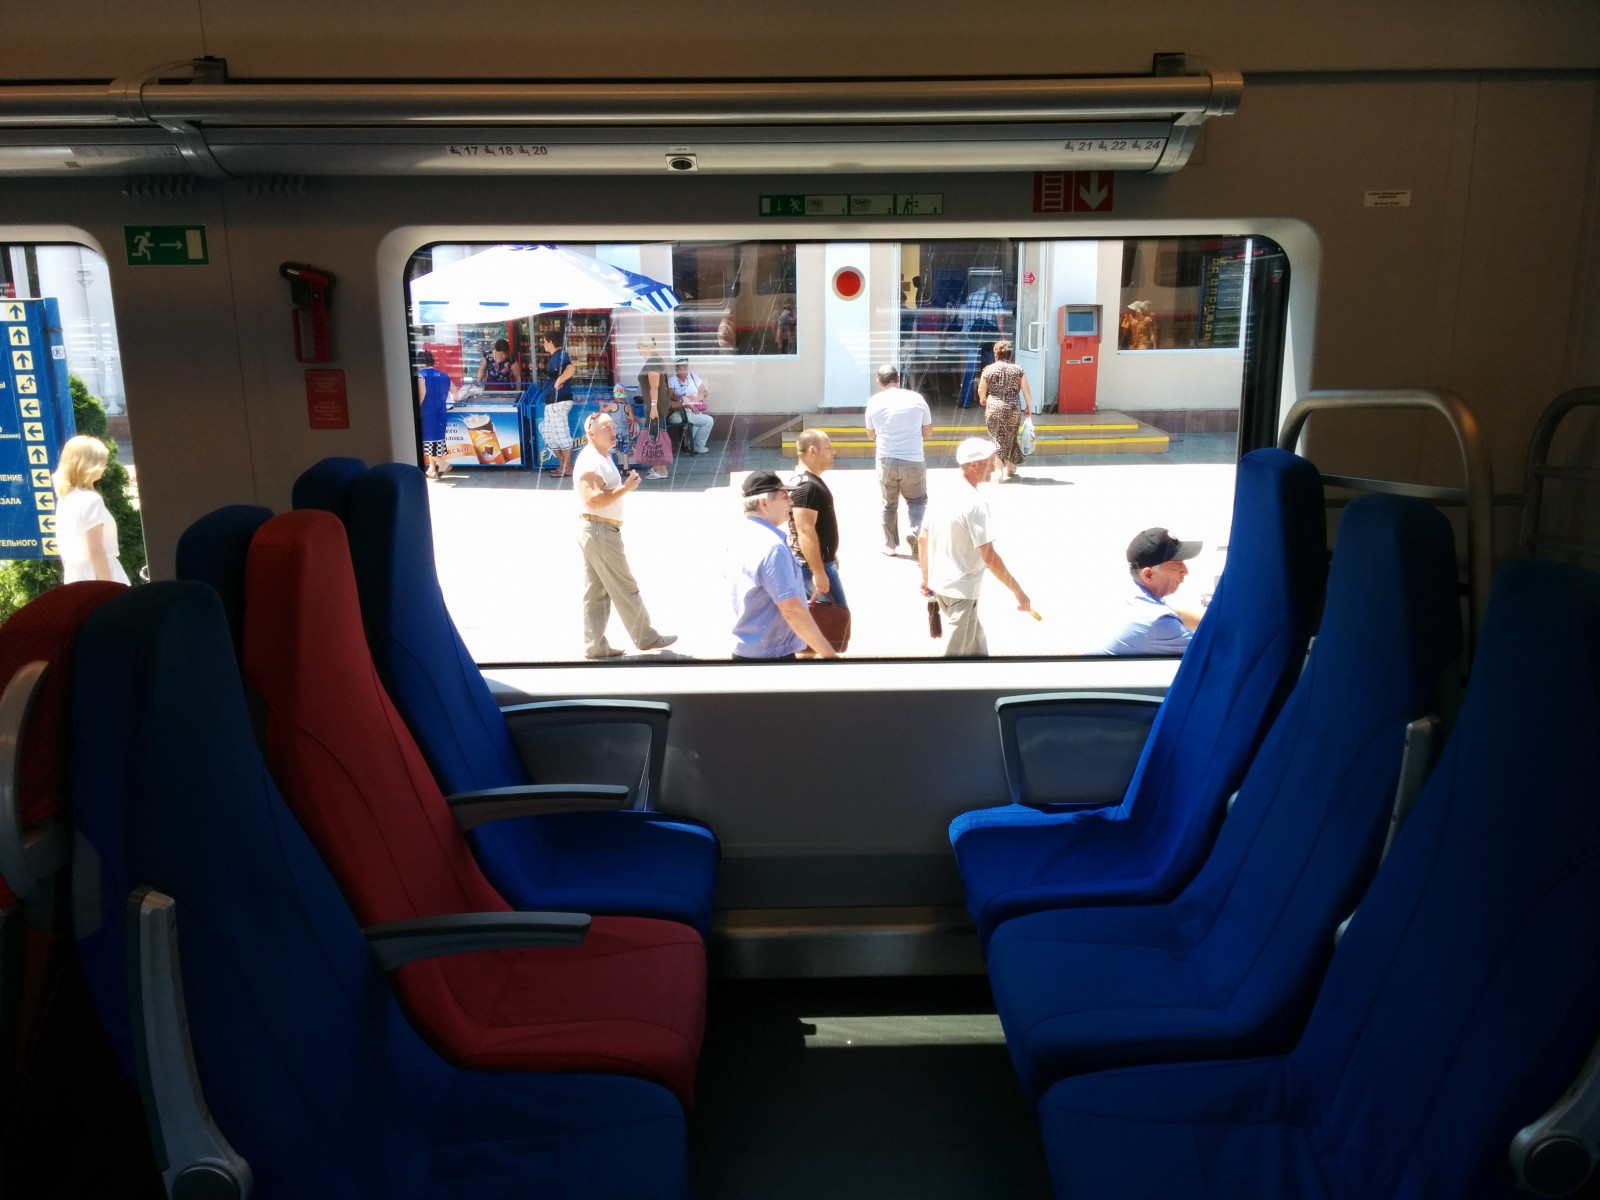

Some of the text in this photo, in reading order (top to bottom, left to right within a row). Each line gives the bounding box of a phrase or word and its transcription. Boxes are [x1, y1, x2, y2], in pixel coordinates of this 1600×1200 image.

[1077, 140, 1160, 150] 21 22 24
[464, 146, 547, 155] 17 18 20
